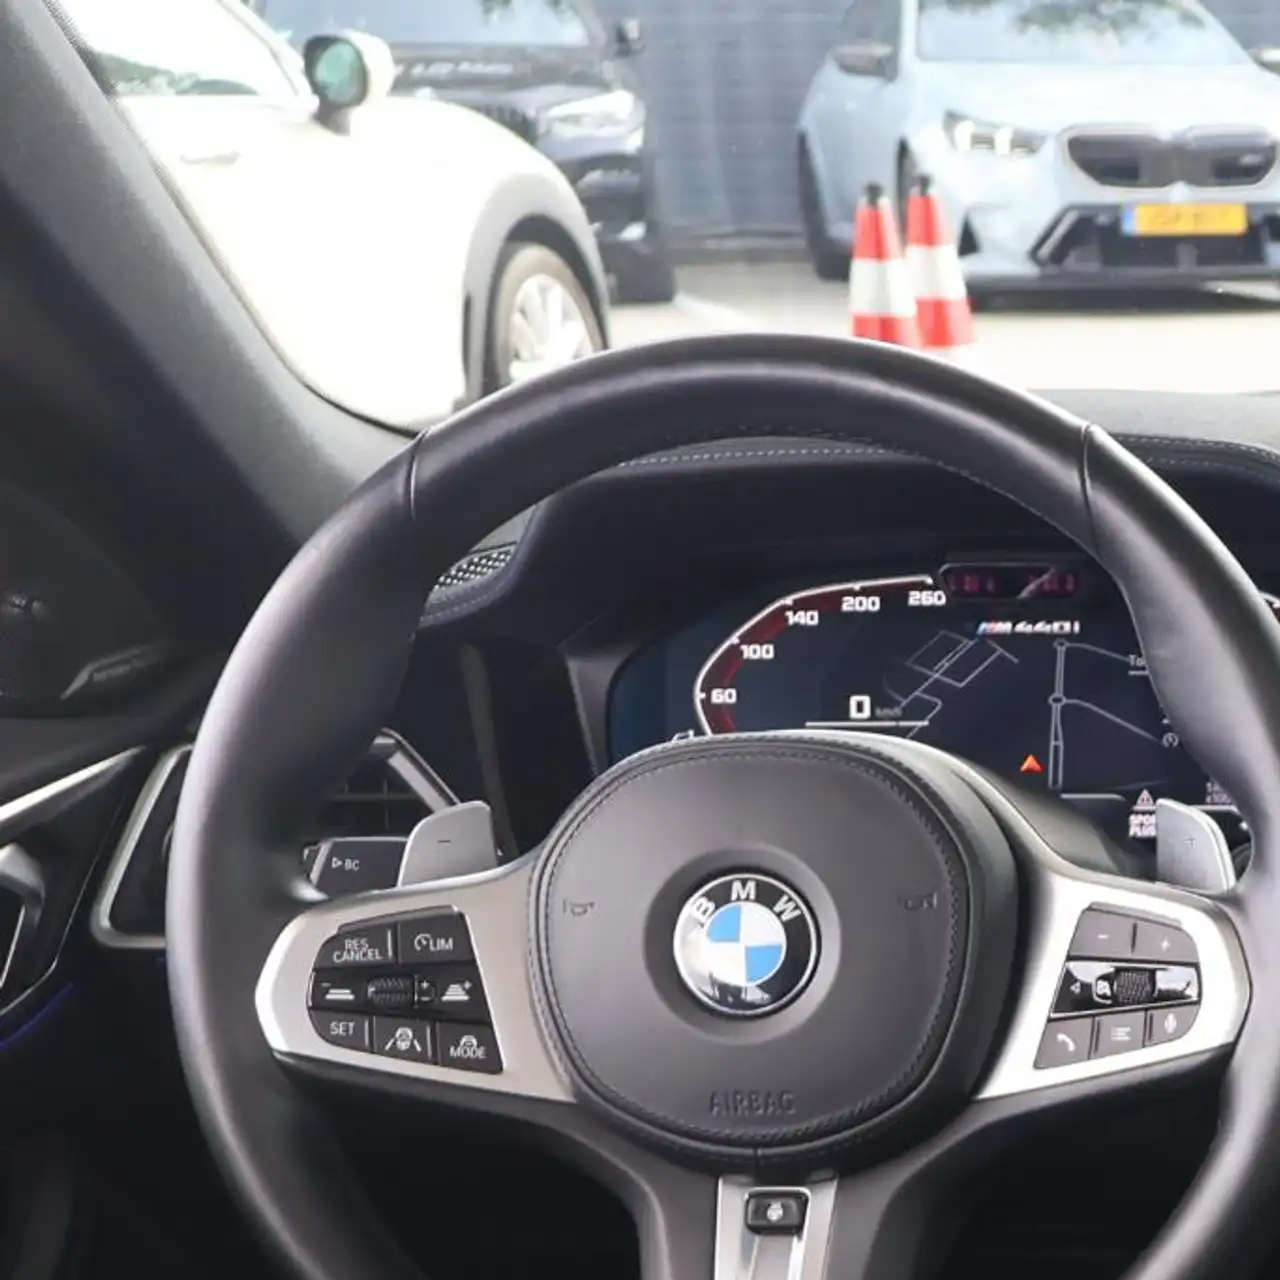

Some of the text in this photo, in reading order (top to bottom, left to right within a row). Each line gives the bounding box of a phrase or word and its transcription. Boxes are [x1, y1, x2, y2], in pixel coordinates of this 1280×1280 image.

[841, 596, 880, 612] 200
[907, 590, 946, 606] 260
[785, 610, 819, 627] 140
[740, 643, 775, 660] 100
[711, 688, 738, 704] 60
[849, 694, 872, 720] 0
[690, 879, 801, 923] BMW
[344, 938, 369, 951] RES
[428, 937, 454, 951] LIM
[332, 949, 382, 964] CANCEL
[330, 1021, 355, 1037] SET
[449, 1045, 487, 1060] MODE
[709, 1091, 797, 1117] AIRBAG
